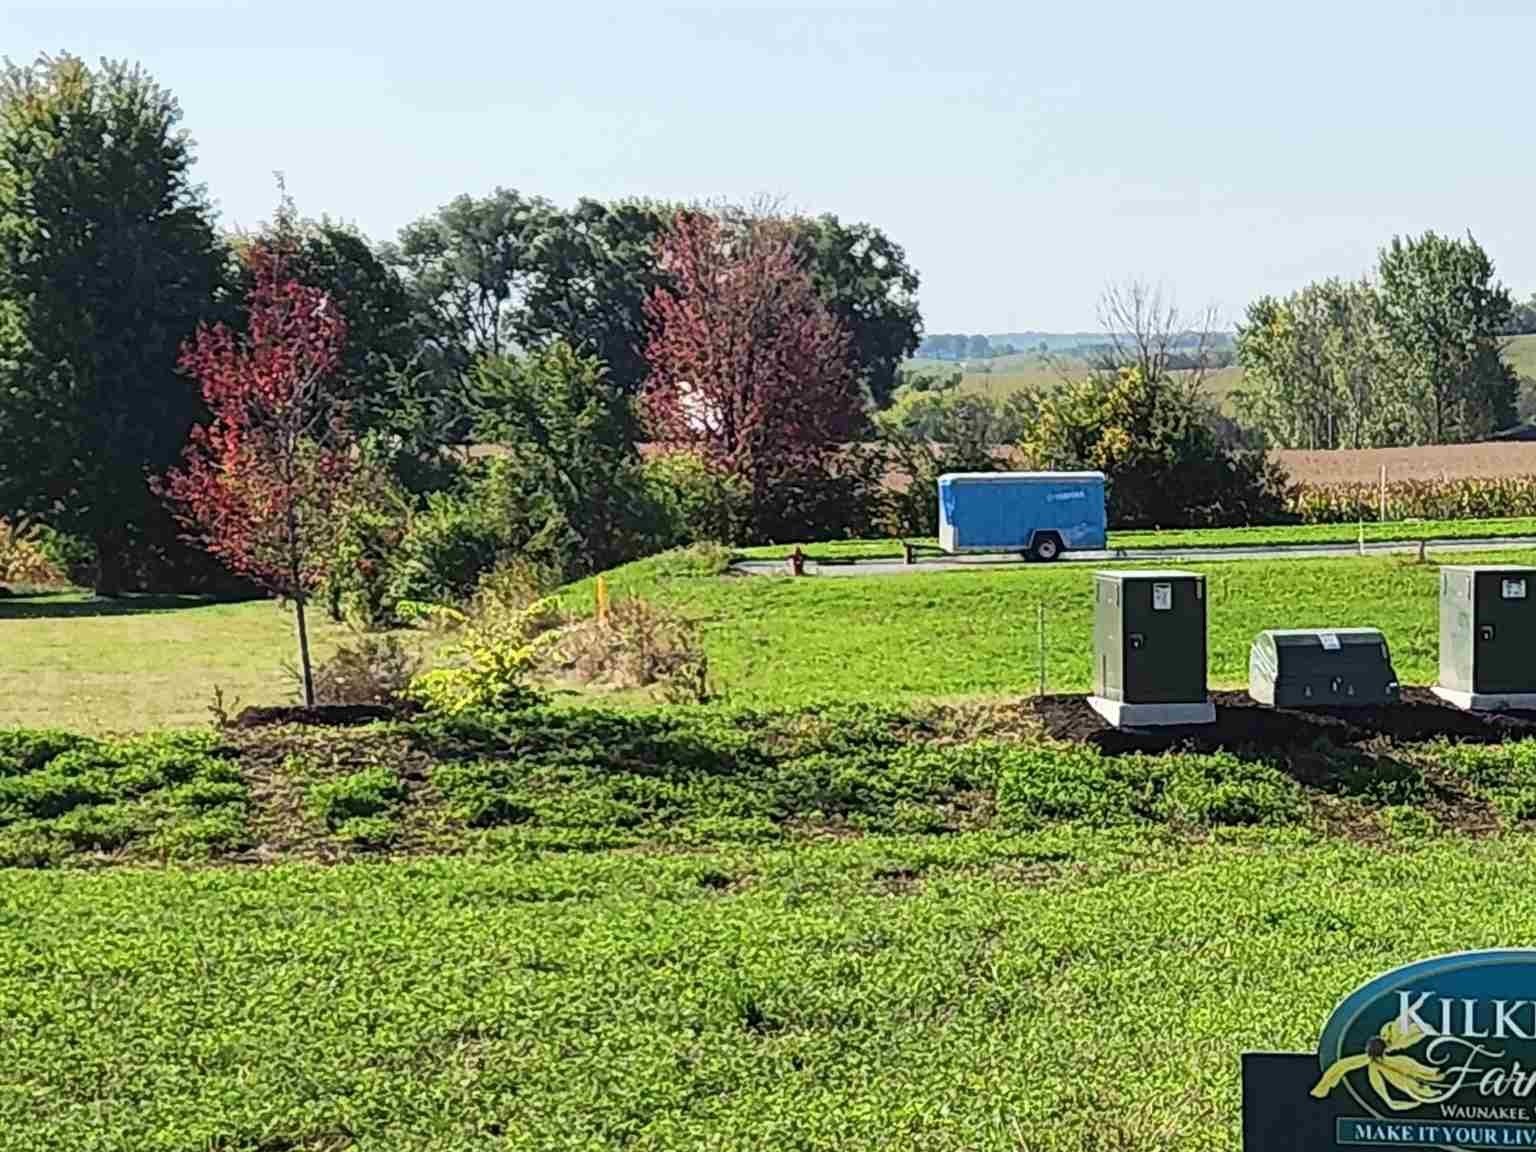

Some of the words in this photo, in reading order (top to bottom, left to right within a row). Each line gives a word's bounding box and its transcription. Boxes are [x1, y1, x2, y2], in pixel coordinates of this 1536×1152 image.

[1354, 1123, 1414, 1142] MAKE
[1418, 1126, 1440, 1143] IT
[1440, 1127, 1498, 1145] YOUR
